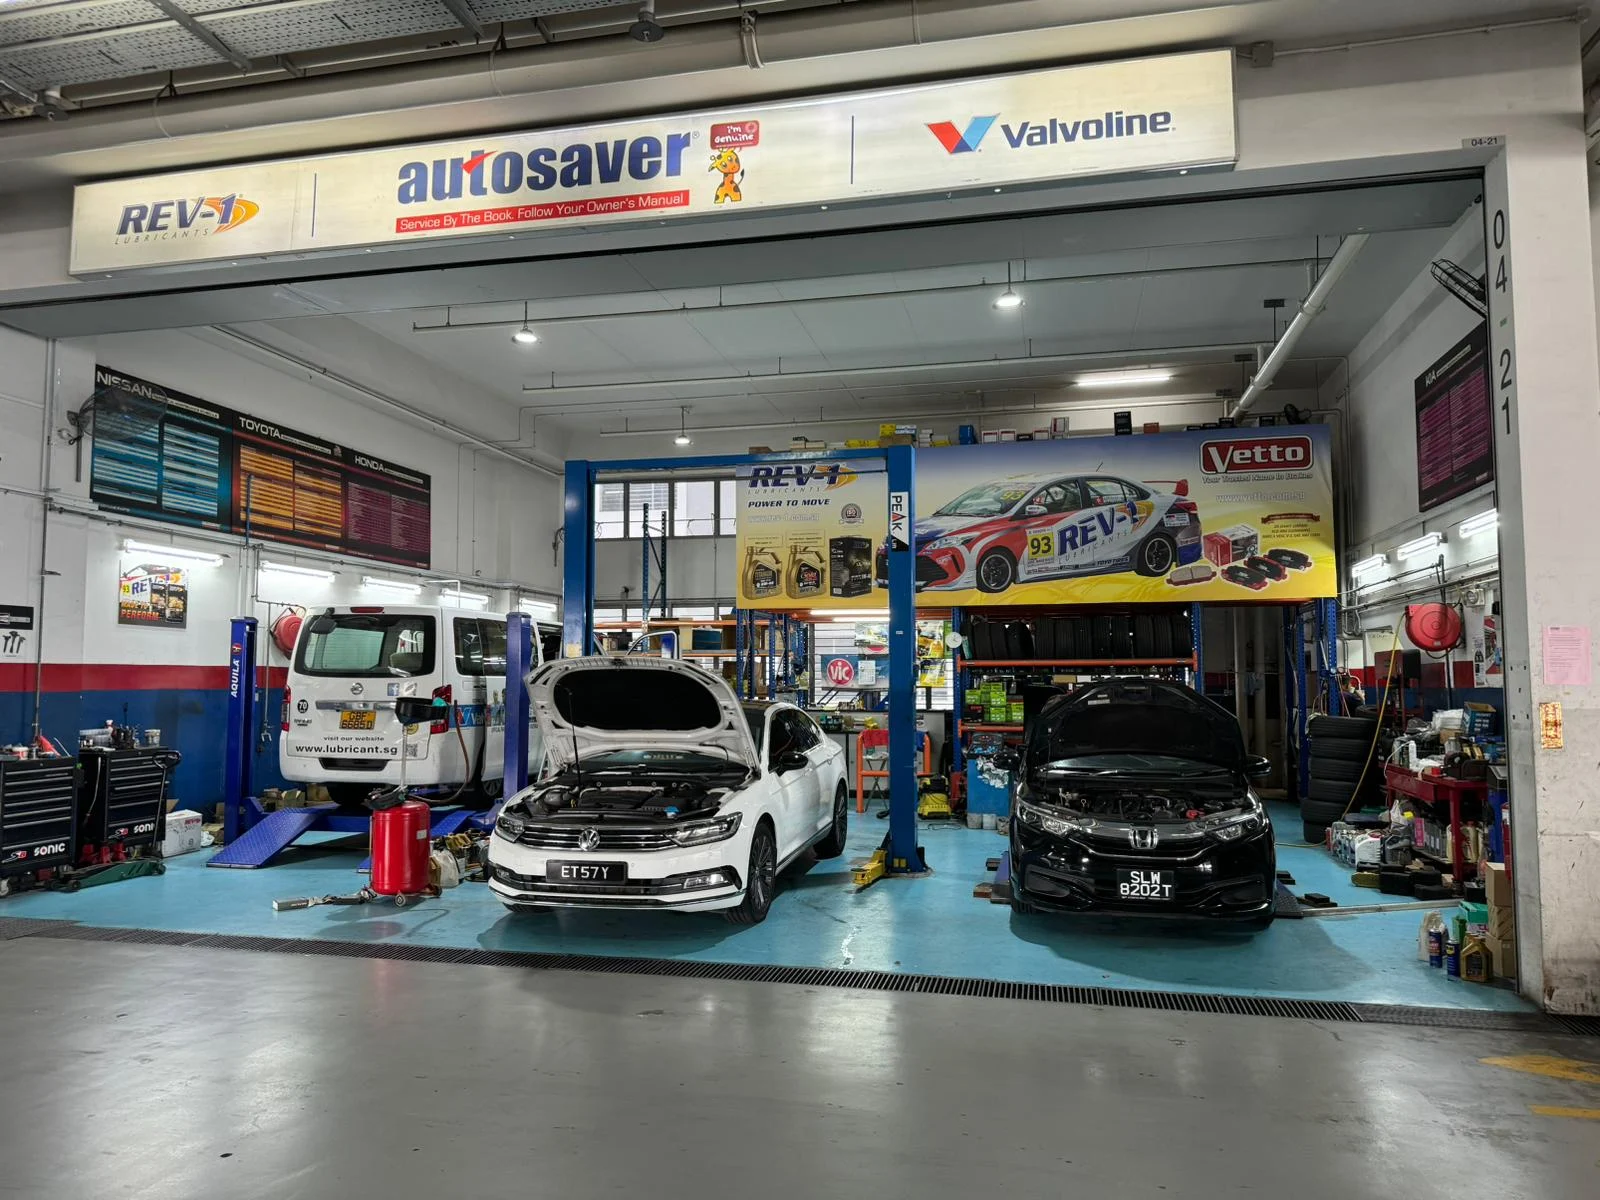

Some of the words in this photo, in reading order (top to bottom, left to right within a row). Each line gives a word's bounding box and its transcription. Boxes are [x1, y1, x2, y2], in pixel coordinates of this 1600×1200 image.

[1001, 111, 1171, 148] Valvoline
[1471, 137, 1498, 146] 04-21
[397, 131, 690, 205] autosaver
[116, 193, 236, 235] REV-1
[400, 219, 440, 230] Service
[444, 214, 457, 228] By
[460, 213, 480, 223] The
[484, 210, 514, 222] Book.
[518, 206, 554, 219] Follow
[556, 203, 584, 215] Your
[587, 197, 635, 212] Owner's
[639, 192, 684, 207] Manual
[115, 228, 209, 245] LUBRICANTS
[96, 370, 152, 399] NISSAN
[239, 416, 281, 439] TOYOTA
[354, 455, 384, 472] HONDA
[1208, 445, 1304, 473] Vetto
[748, 463, 841, 488] REV-1
[748, 486, 820, 494] LUBRICANTS
[748, 500, 782, 508] POWER
[786, 499, 798, 507] TO
[802, 498, 831, 506] MOVE
[892, 495, 907, 531] PEAK
[1058, 501, 1139, 556] REV-1
[1030, 535, 1052, 555] 93
[231, 658, 240, 698] AQUILA
[349, 711, 367, 720] GBF
[295, 744, 398, 755] www.lubricant.sg
[133, 822, 156, 834] SONI
[1130, 871, 1160, 884] SLW
[1120, 883, 1172, 897] 8202T
